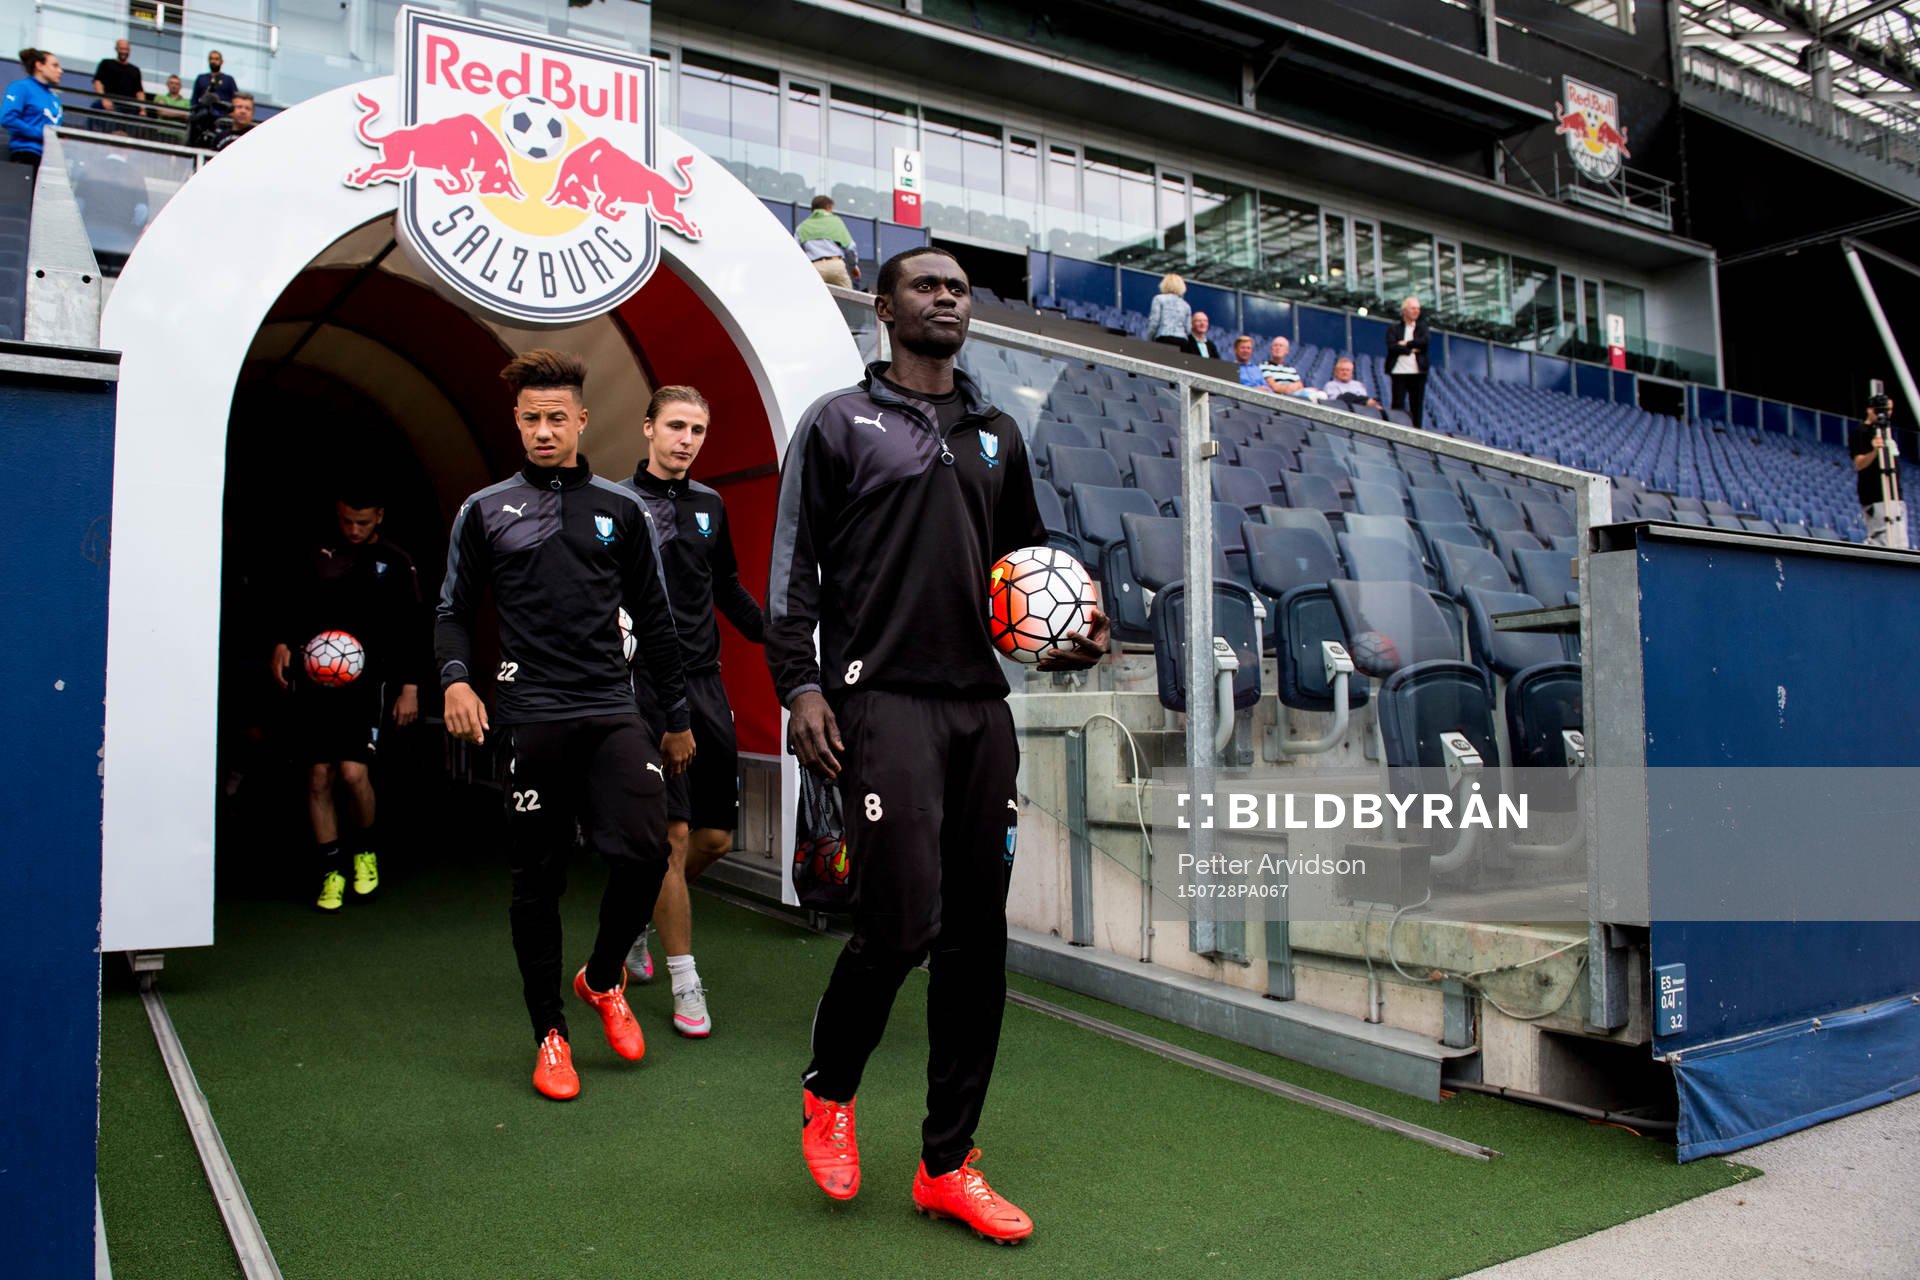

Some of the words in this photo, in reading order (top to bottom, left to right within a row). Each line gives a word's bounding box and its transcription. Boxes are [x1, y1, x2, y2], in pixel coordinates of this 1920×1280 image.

[426, 34, 530, 98] Red
[542, 58, 638, 124] Bull
[903, 154, 913, 172] 6
[432, 204, 632, 298] SALZBURG
[497, 661, 519, 682] 22
[844, 660, 863, 685] 8
[513, 789, 541, 812] 22
[864, 792, 883, 822] 8
[1661, 976, 1671, 989] ES
